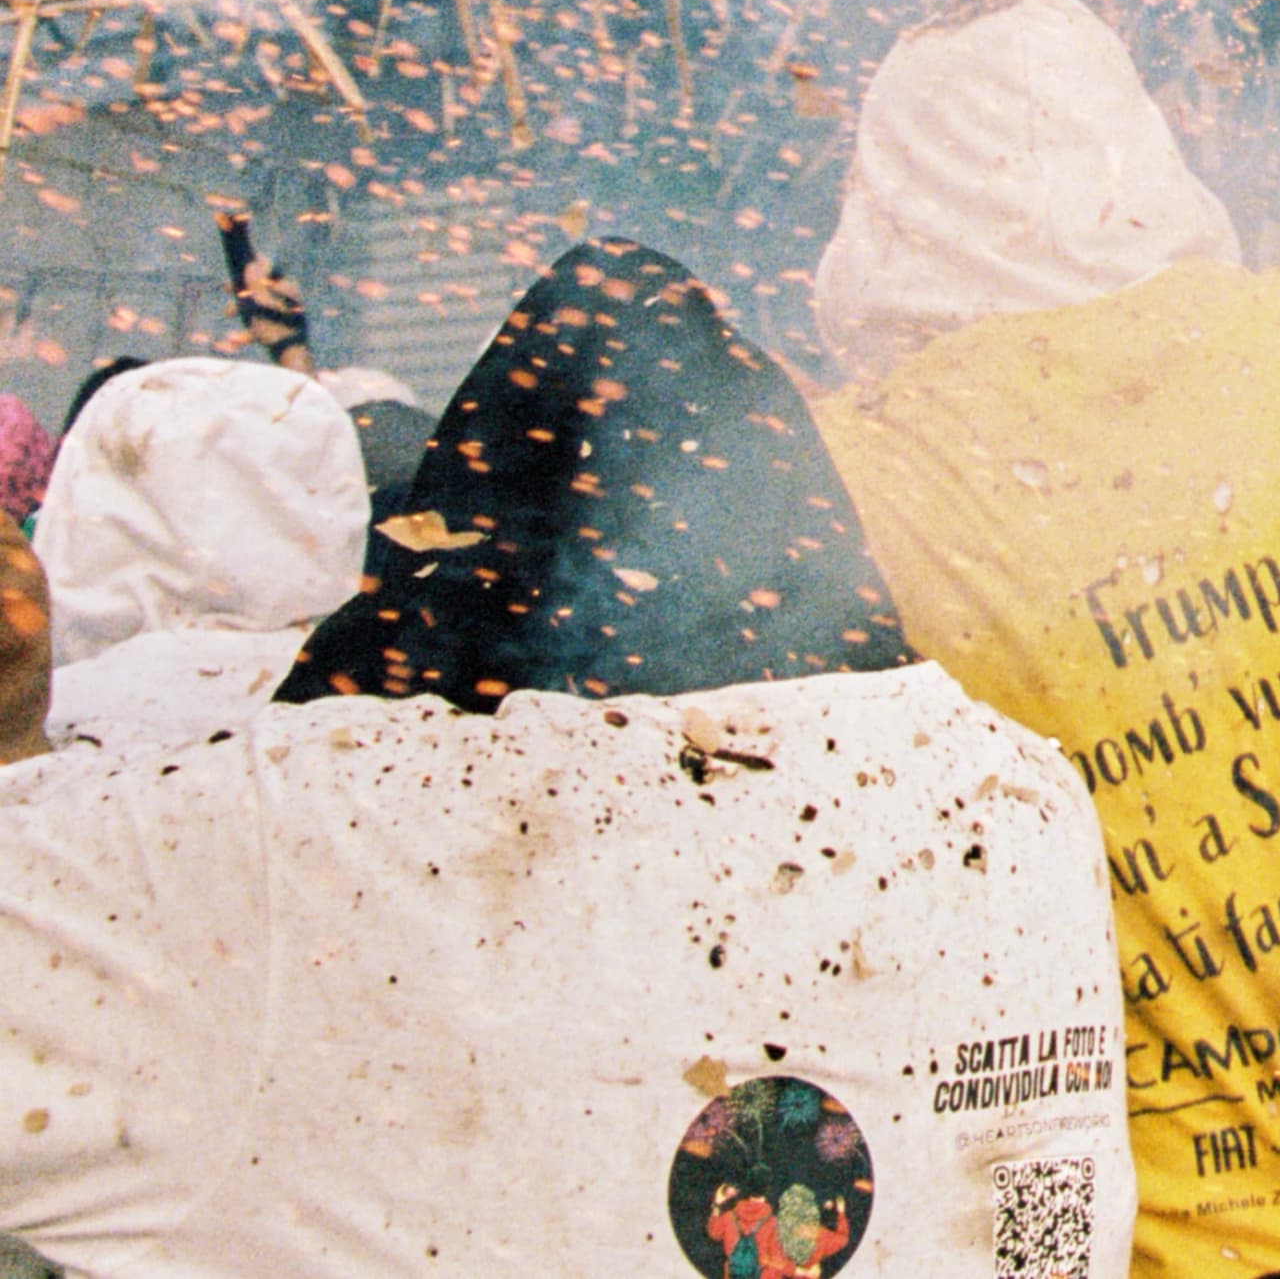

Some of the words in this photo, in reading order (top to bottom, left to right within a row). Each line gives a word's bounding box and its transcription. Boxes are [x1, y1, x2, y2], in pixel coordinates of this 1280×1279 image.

[1194, 813, 1235, 864] a
[1121, 951, 1173, 1006] a
[1164, 905, 1224, 983] ti
[954, 1033, 1031, 1075] SCATTA
[1037, 1029, 1058, 1063] LA
[1063, 1025, 1096, 1058] FOTO
[1098, 1024, 1107, 1056] E
[933, 1063, 1060, 1114] CONDIVIDILA
[1064, 1060, 1092, 1094] CON
[1094, 1058, 1113, 1090] NOI
[1192, 1123, 1258, 1178] FIAT
